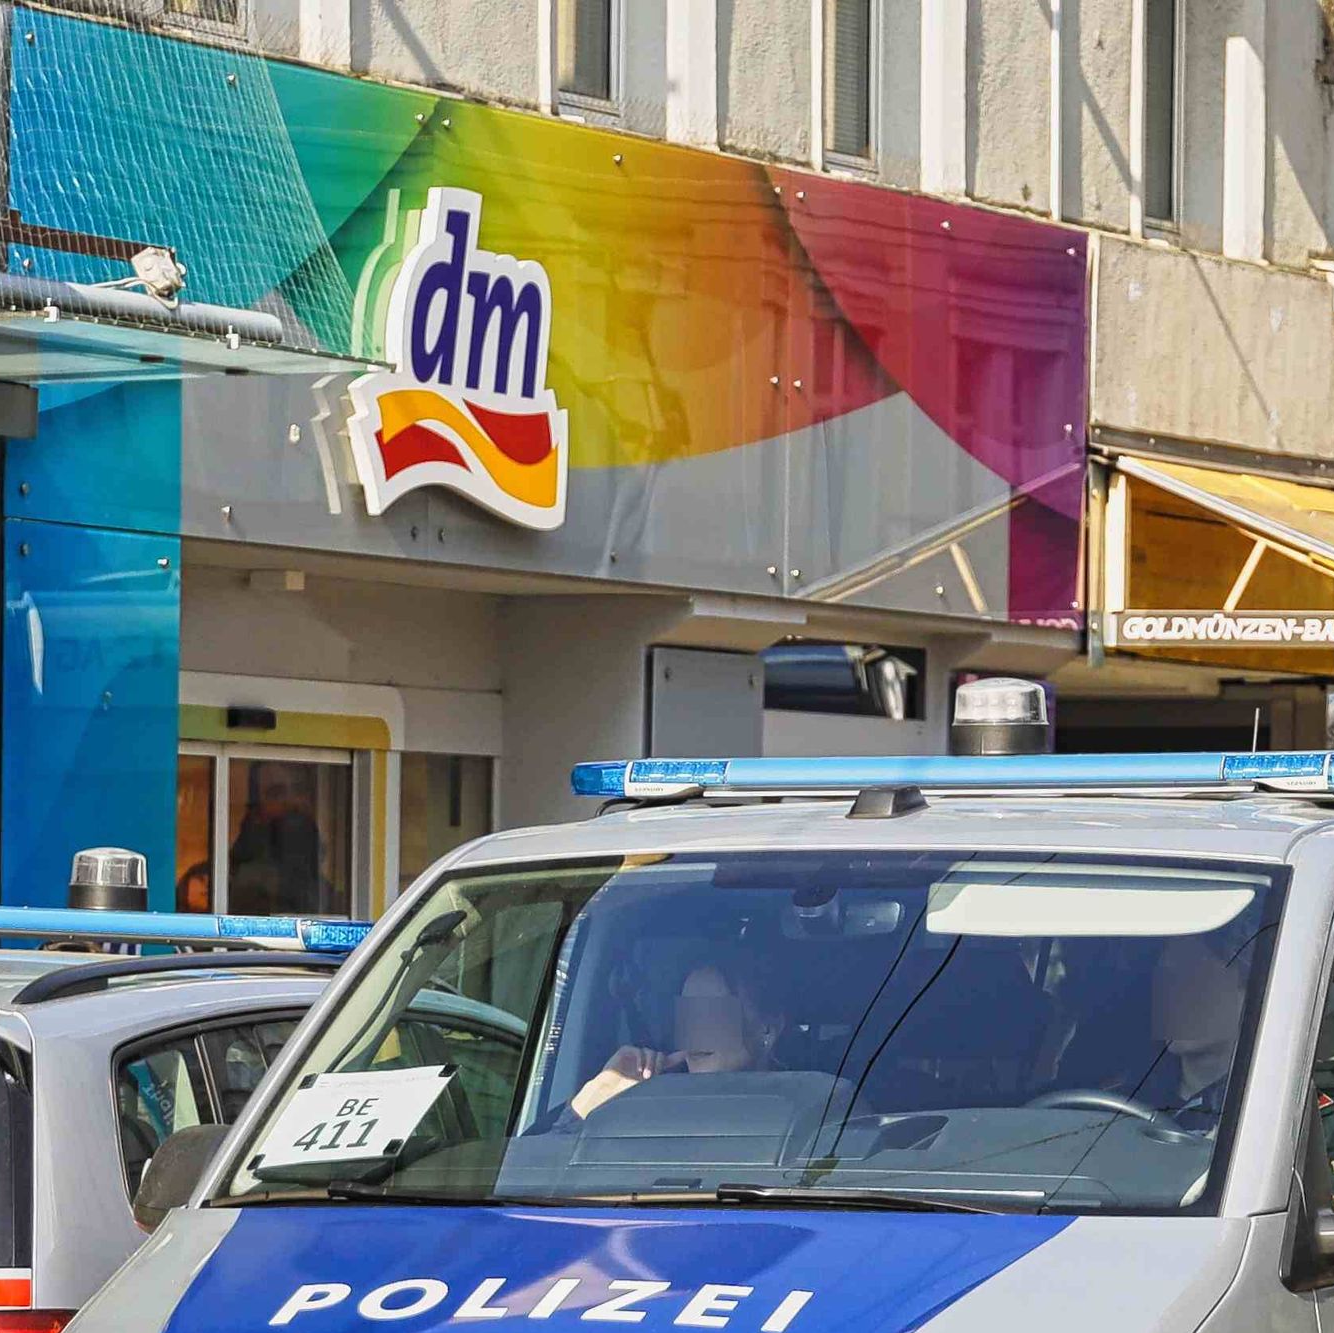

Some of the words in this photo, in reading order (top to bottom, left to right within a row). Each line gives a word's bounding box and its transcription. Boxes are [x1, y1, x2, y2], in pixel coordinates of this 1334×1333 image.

[411, 209, 542, 399] dm
[336, 1097, 380, 1117] BE
[293, 1118, 380, 1152] 411
[268, 1277, 814, 1333] POLIZEI
